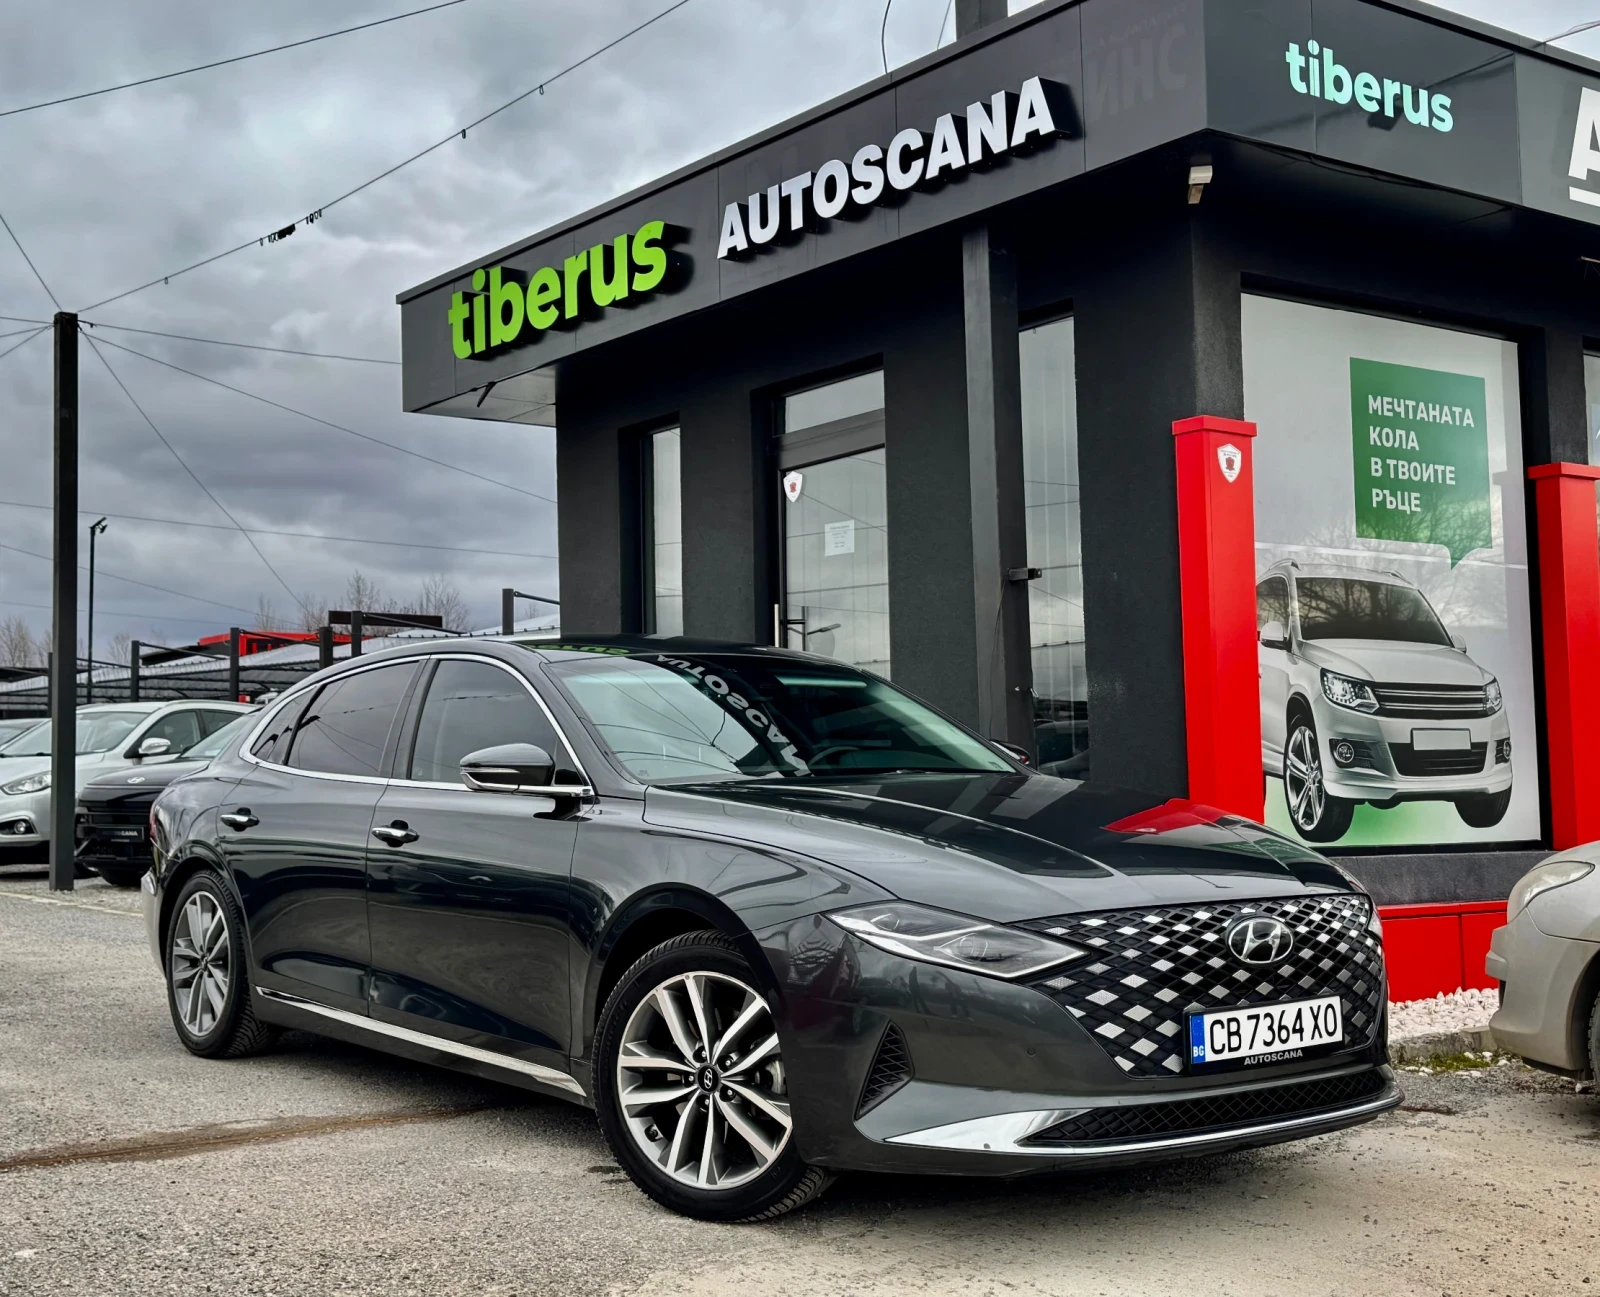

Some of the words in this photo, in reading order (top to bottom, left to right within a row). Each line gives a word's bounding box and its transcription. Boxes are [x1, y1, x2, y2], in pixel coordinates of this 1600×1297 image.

[1285, 39, 1454, 133] tiberus
[716, 76, 1055, 260] AUTOSCANA
[447, 220, 667, 359] tiberus
[1368, 394, 1475, 428] МЕЧТАНАТА
[1369, 425, 1420, 451] КОЛА
[1370, 456, 1383, 477] В
[1386, 458, 1456, 485] ТВОИТЕ
[1371, 487, 1422, 515] РЪЦЕ
[1193, 1046, 1205, 1057] BG
[1244, 1049, 1304, 1066] AUTOSCANA
